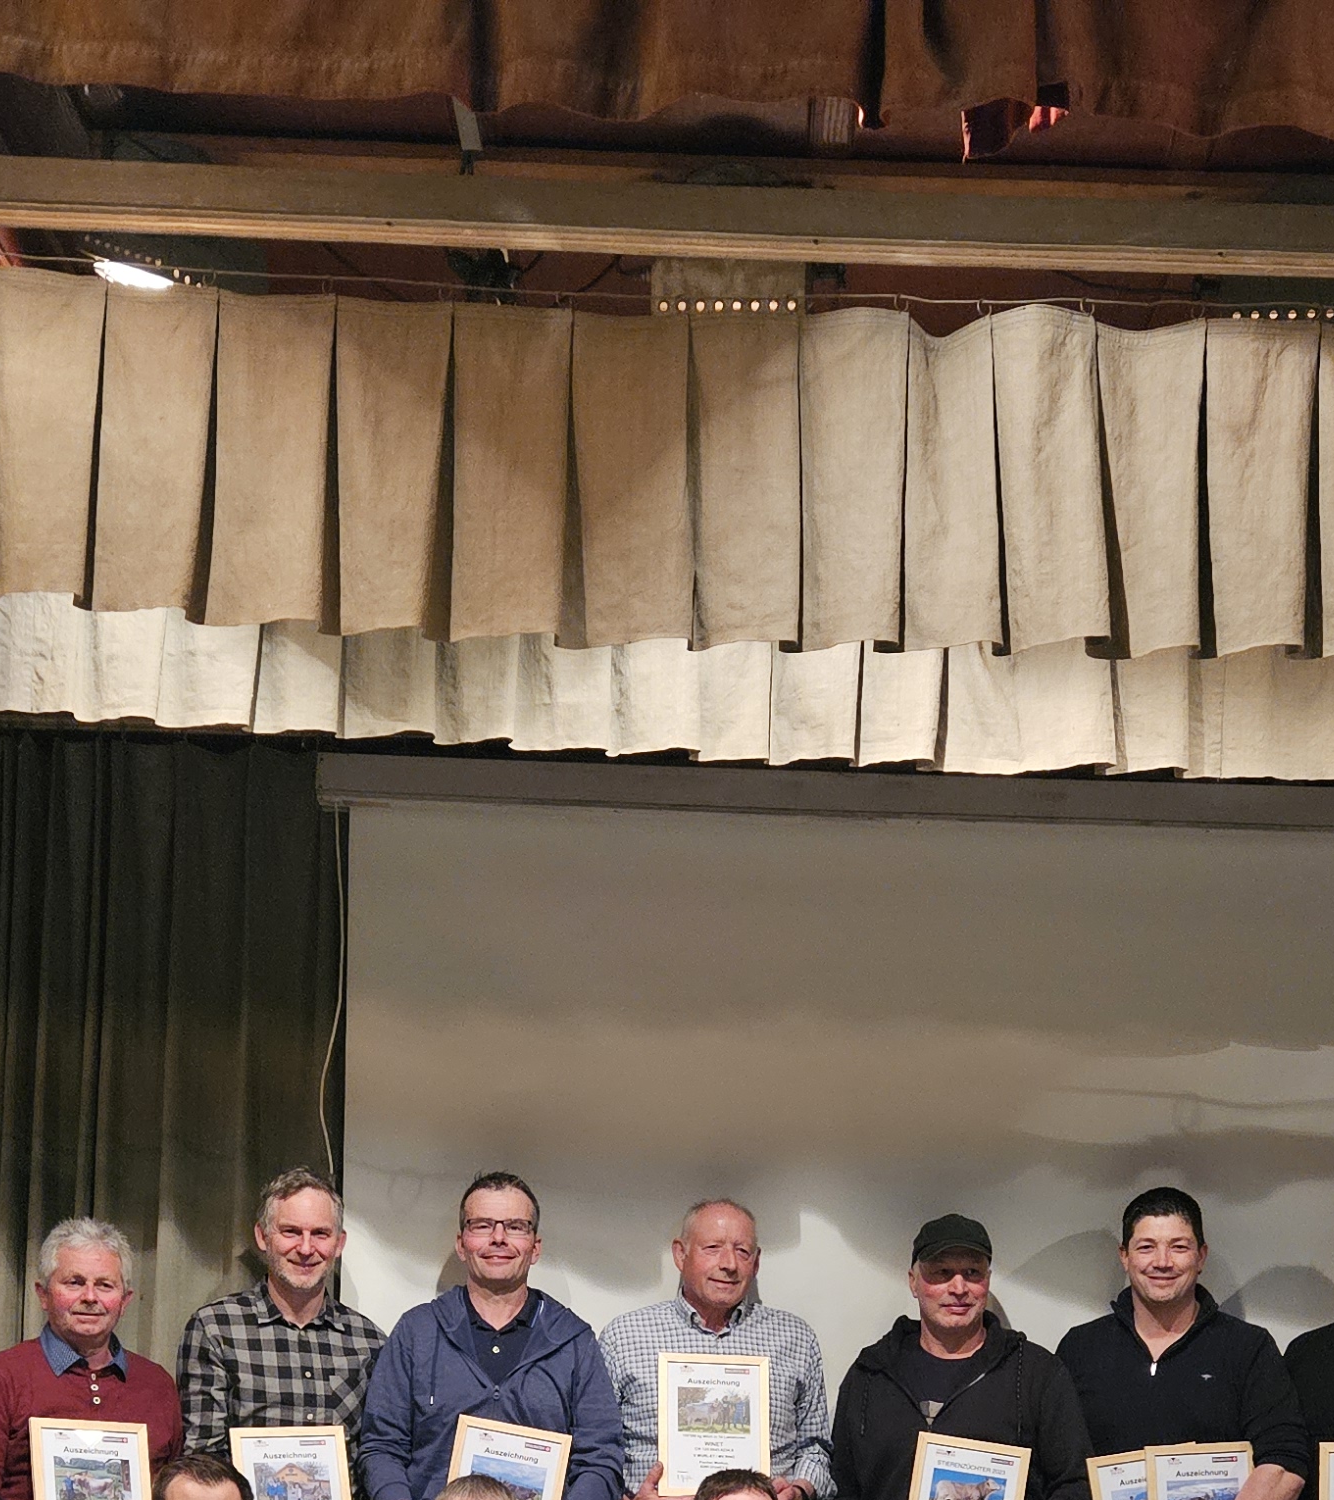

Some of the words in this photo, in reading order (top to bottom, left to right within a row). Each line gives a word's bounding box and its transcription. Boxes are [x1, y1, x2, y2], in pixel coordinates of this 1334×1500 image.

[687, 1378, 740, 1386] Auszeichnung
[63, 1446, 119, 1456] Auszeichnung
[484, 1447, 539, 1464] Auszeichnung
[937, 1460, 991, 1473] STIERENZÜCHTER
[1176, 1469, 1229, 1477] Auszeichnung
